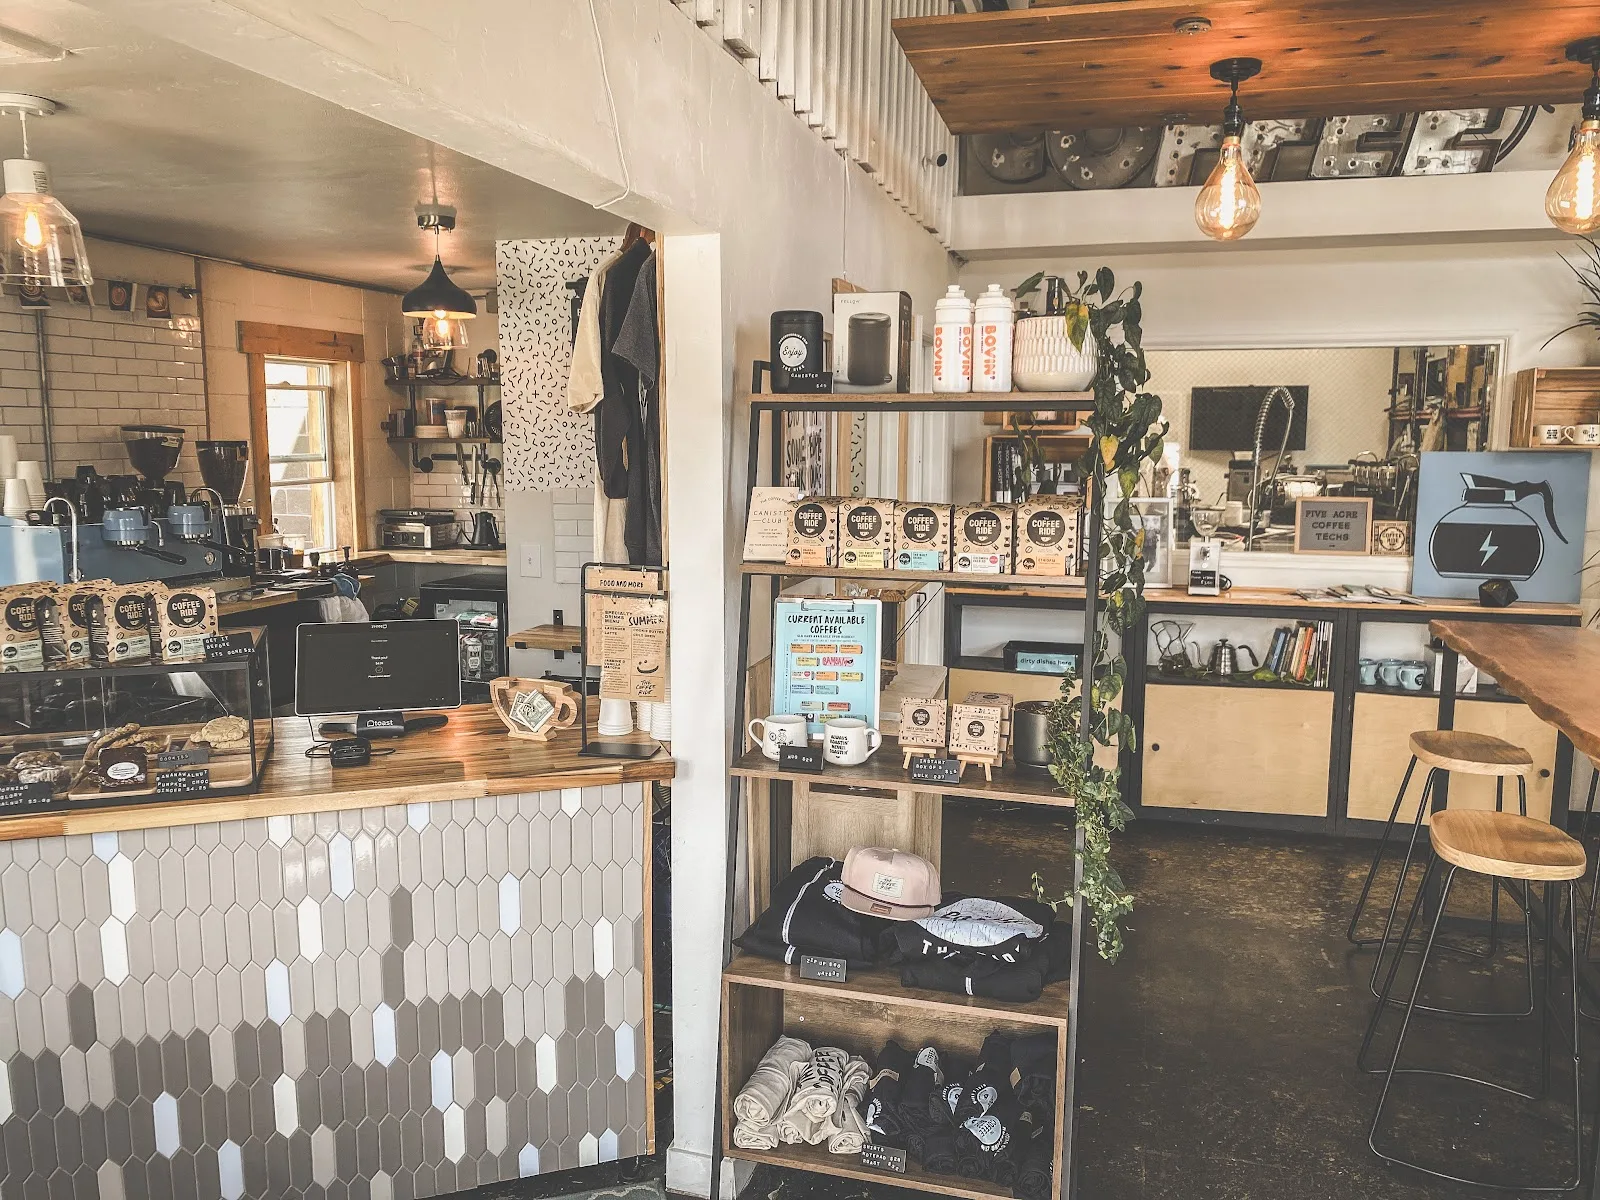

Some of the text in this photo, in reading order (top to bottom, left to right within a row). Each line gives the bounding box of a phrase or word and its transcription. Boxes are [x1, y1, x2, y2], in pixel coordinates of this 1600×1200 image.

[120, 603, 146, 613] COFFEE
[172, 601, 200, 610] COFFEE
[10, 605, 35, 616] COFFE
[180, 608, 198, 617] RIDE
[127, 611, 143, 620] RIDE
[788, 615, 865, 624] CURRENT AVAILABLE
[810, 626, 842, 634] COFFEES
[863, 1144, 884, 1152] SHIRTS
[862, 1152, 886, 1160] NOTEPAD
